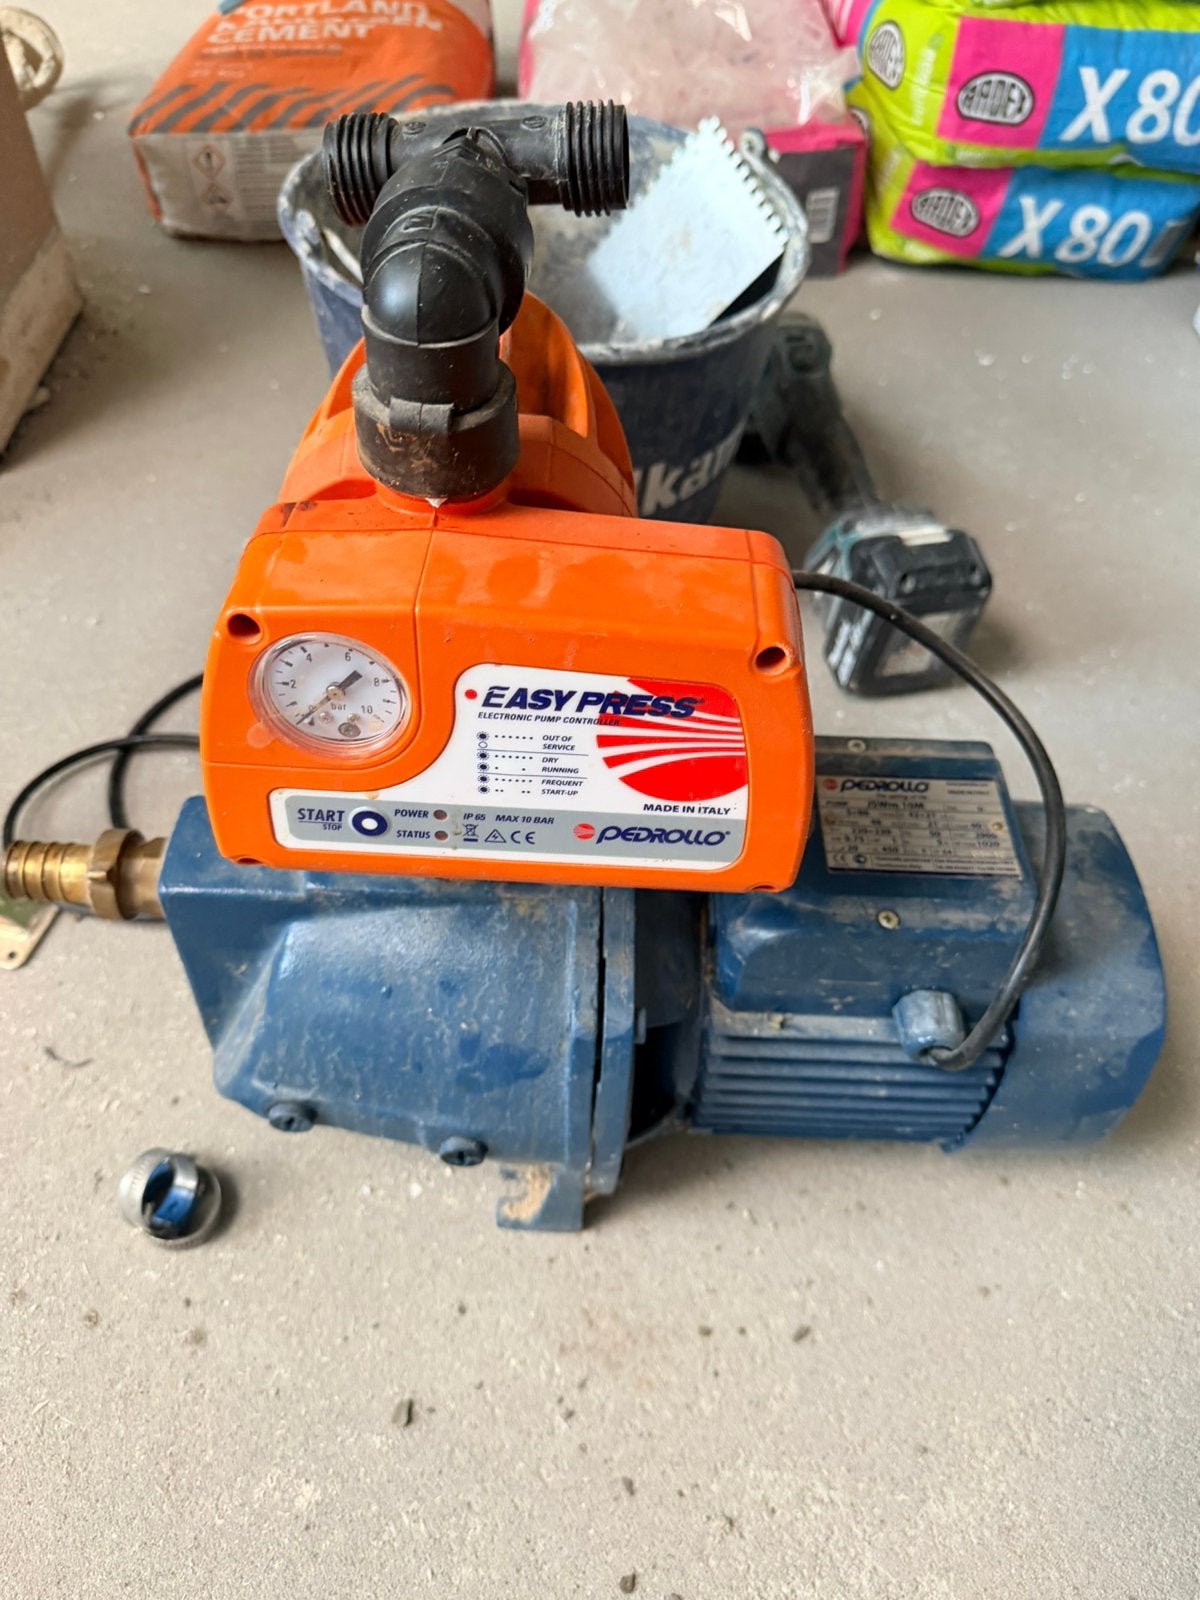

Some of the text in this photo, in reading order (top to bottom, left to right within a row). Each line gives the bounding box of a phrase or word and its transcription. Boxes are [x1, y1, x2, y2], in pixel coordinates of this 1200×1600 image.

[1059, 67, 1130, 143] X
[997, 195, 1151, 267] X 80
[306, 654, 313, 663] 4
[345, 652, 351, 662] 6
[290, 680, 297, 689] 2
[374, 678, 380, 687] 8
[481, 685, 700, 719] EASY PRESS
[331, 703, 347, 711] bar
[361, 705, 373, 714] 10
[477, 711, 620, 727] ELECTRONIC PUMP CONTROLLER
[542, 743, 576, 751] SERVICE
[541, 766, 579, 774] RUNNING
[541, 779, 583, 787] FREQUENT
[541, 788, 579, 796] START-UP
[394, 809, 429, 818] POWER
[643, 803, 731, 815] MADE IN ITALY
[298, 808, 346, 822] START
[495, 814, 519, 823] MAX
[533, 816, 555, 824] BAR
[323, 823, 342, 831] STOP
[396, 830, 431, 839] STATUS
[596, 825, 726, 846] PEDROLLO
